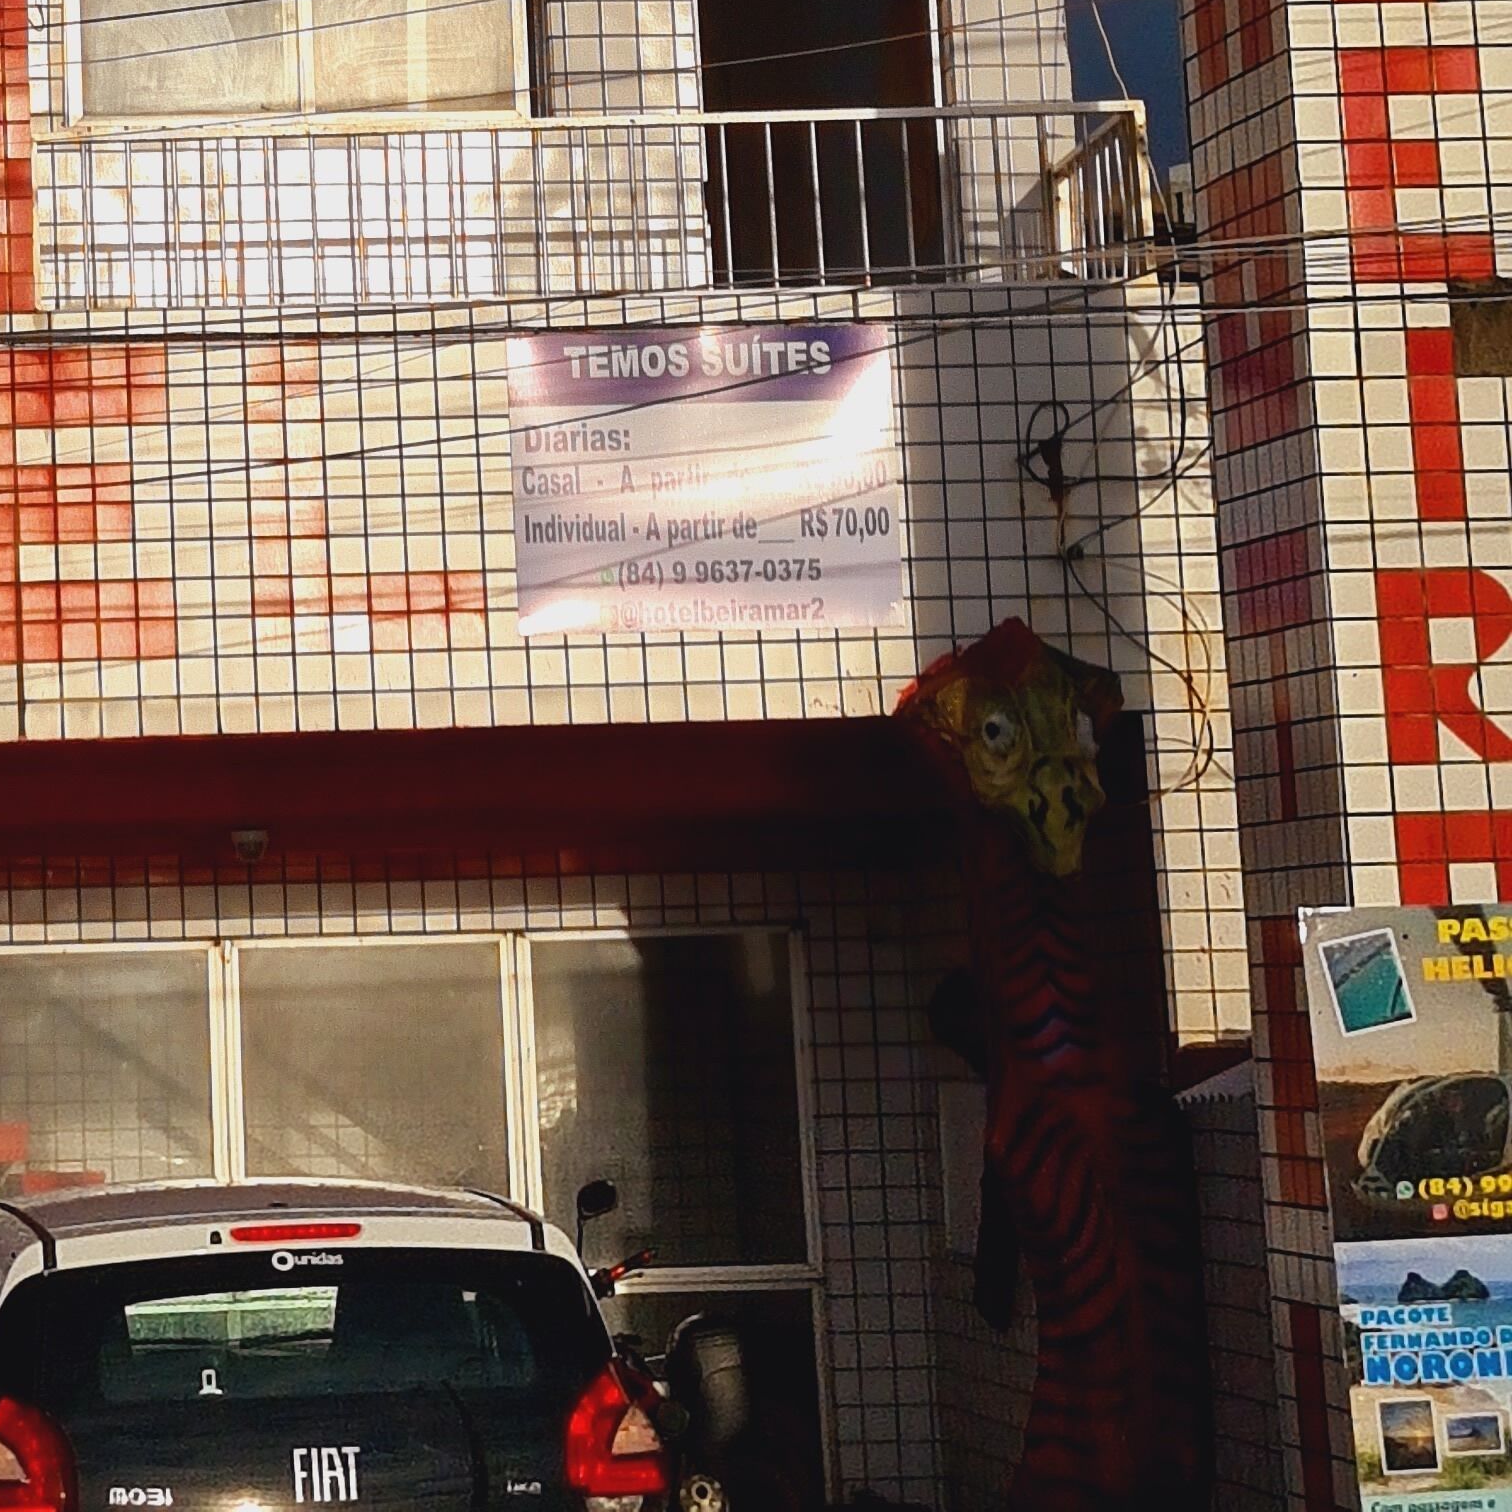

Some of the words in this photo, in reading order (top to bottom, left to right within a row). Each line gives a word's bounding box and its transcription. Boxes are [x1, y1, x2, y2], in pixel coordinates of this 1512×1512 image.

[564, 344, 689, 379] TEMOS
[700, 335, 831, 376] SUÍTES
[521, 465, 581, 496] Casal
[620, 464, 635, 494] A
[524, 512, 626, 544] Individual
[645, 512, 661, 541] A
[668, 511, 726, 548] partir
[618, 560, 664, 591] (84)
[672, 560, 687, 584] 9
[695, 557, 822, 584] 9637-0375
[1437, 915, 1512, 944] PAS
[1422, 953, 1512, 982] HELI
[1418, 1176, 1473, 1200] (84)
[1360, 1305, 1449, 1326] PACOTE
[1363, 1328, 1491, 1351] FERNANDO
[292, 1445, 361, 1504] FIAT
